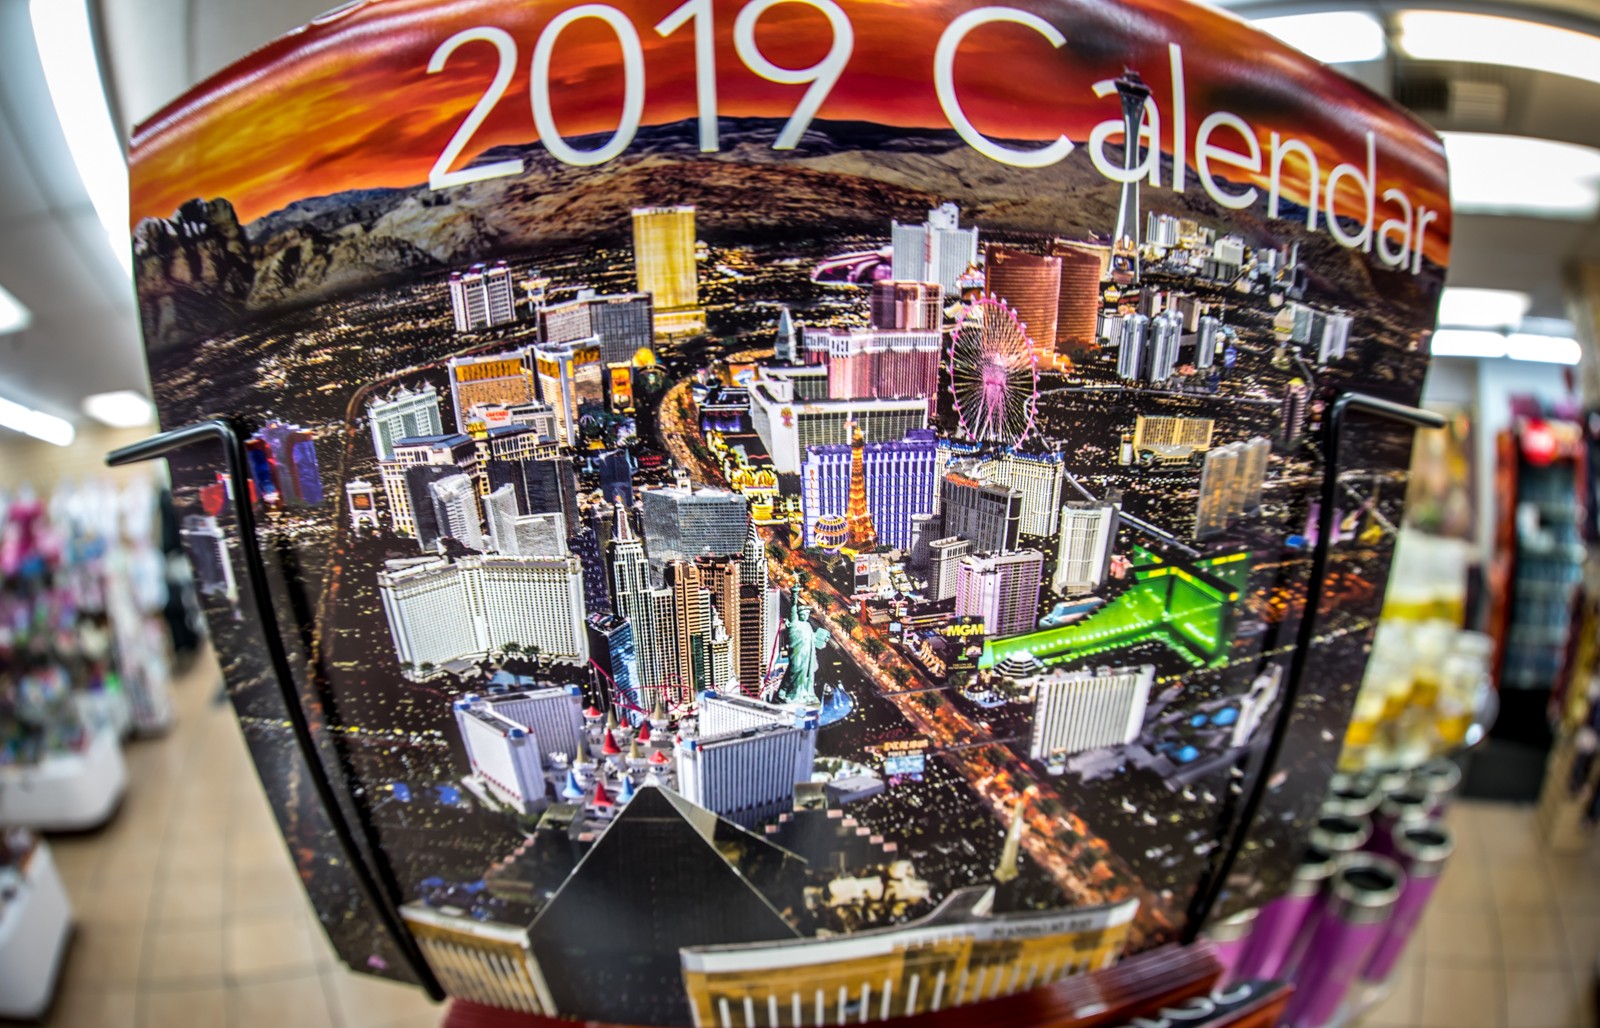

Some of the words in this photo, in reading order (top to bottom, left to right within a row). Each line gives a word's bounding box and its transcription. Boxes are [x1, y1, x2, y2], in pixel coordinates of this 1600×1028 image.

[426, 0, 854, 190] 2019
[933, 6, 1437, 275] Calendar
[946, 623, 984, 637] MGM
